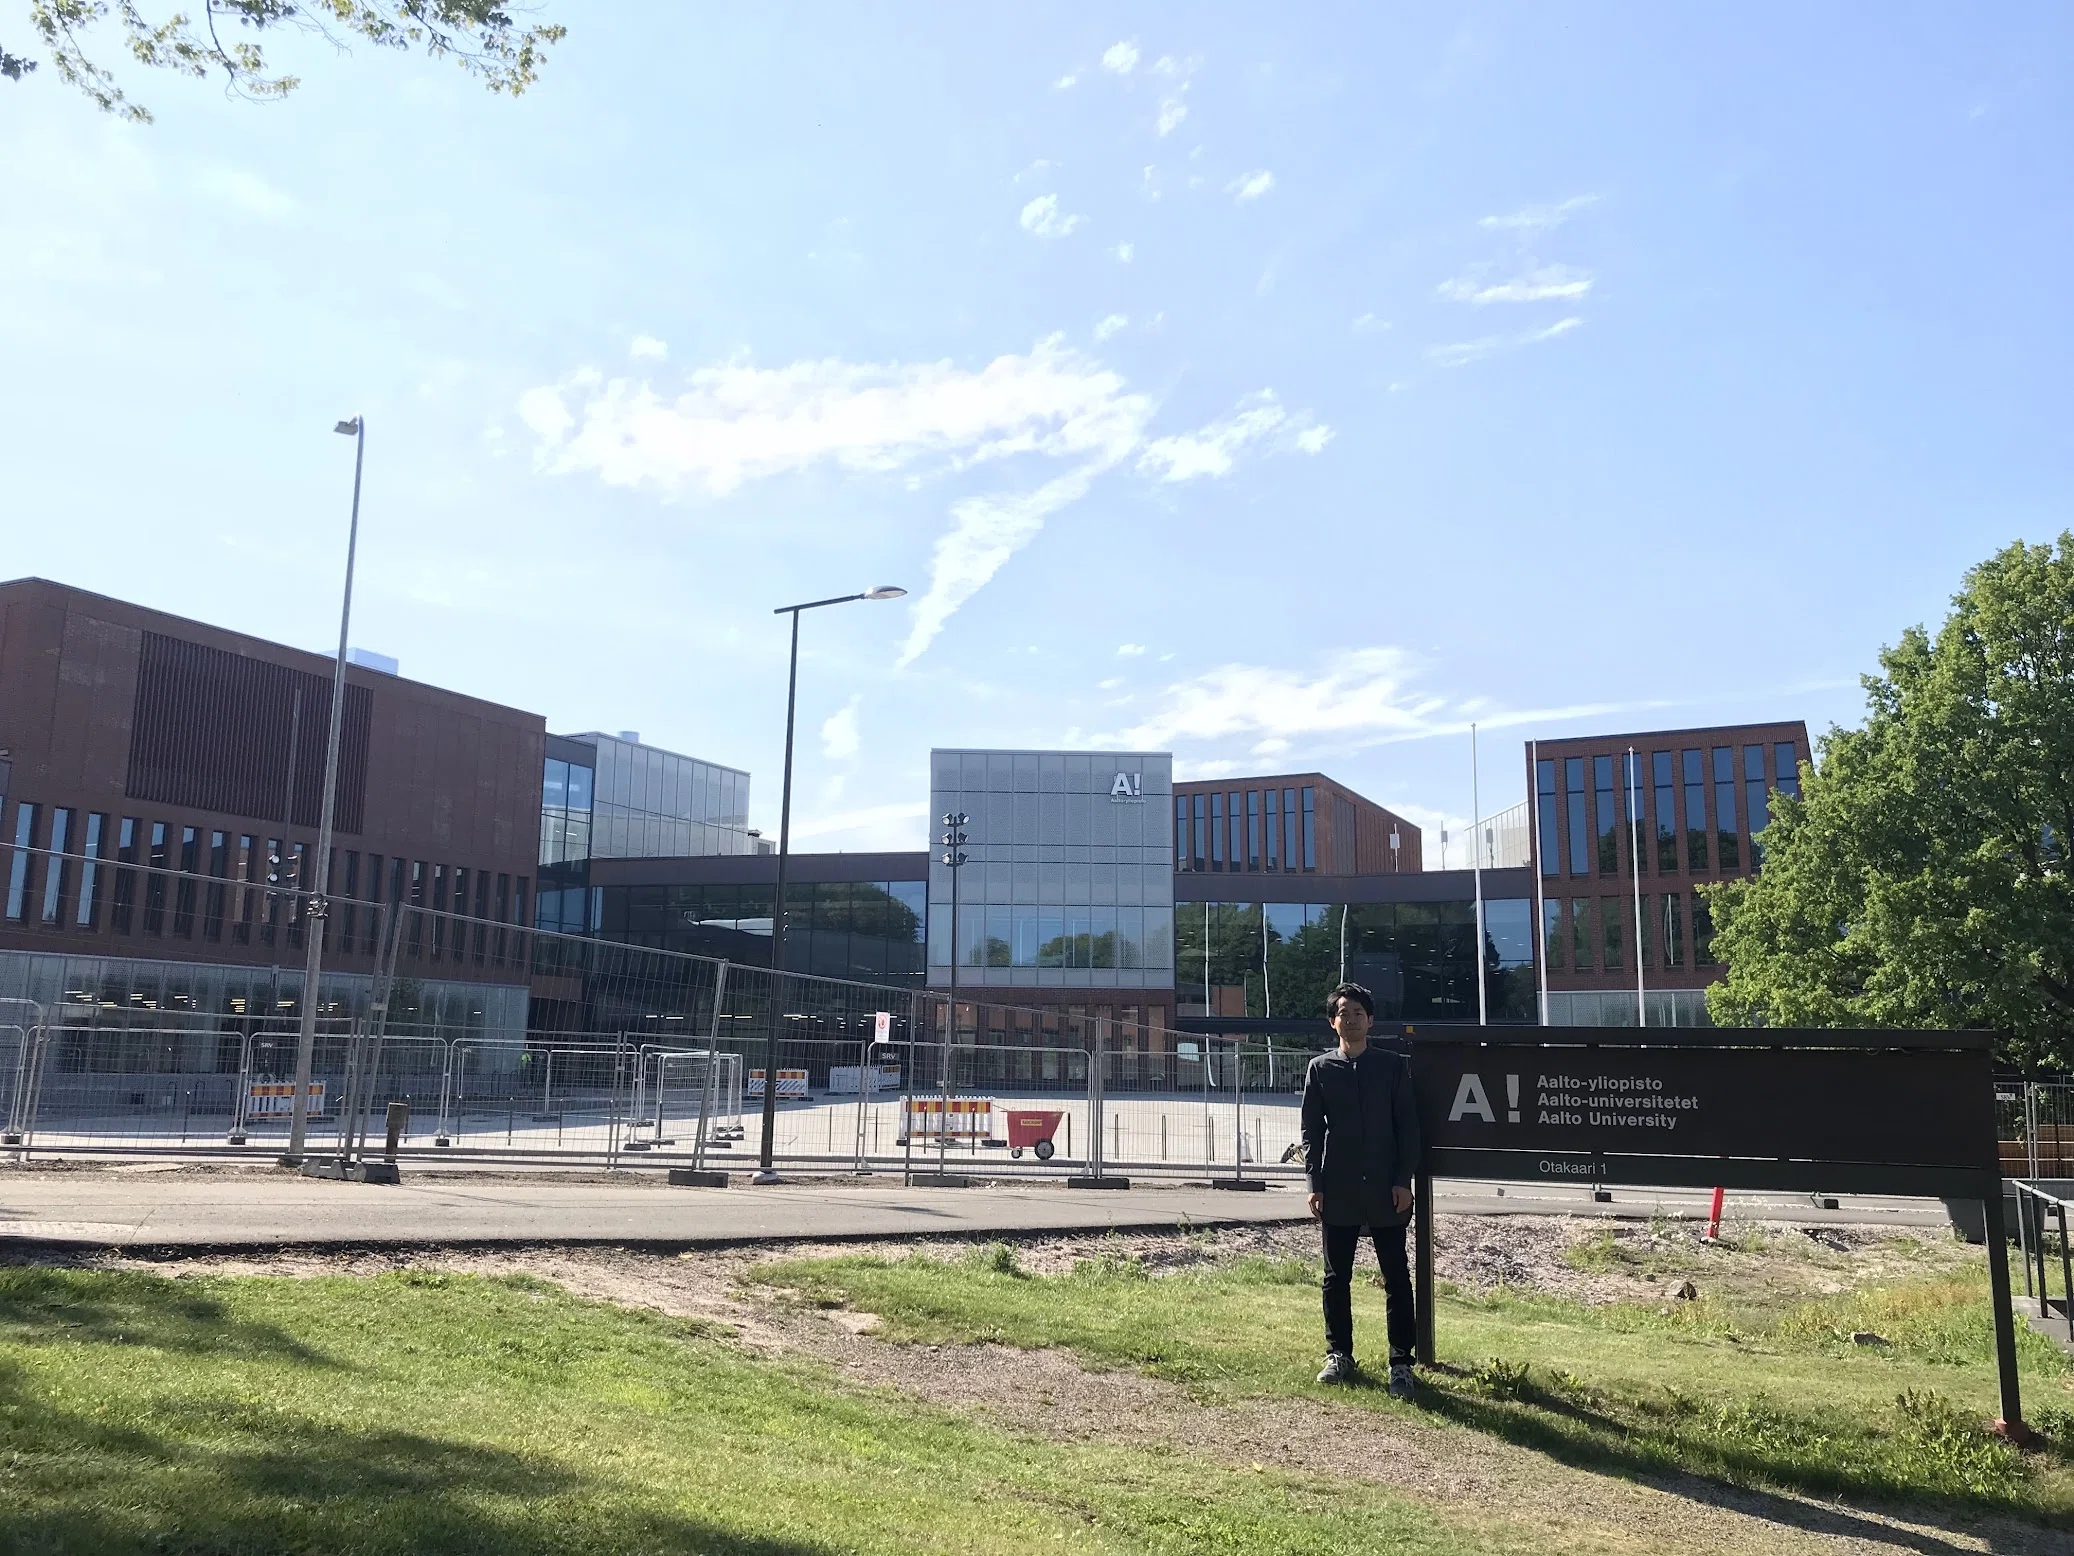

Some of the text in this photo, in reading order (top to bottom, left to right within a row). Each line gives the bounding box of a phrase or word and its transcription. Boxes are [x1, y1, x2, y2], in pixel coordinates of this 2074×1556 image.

[1110, 772, 1141, 796] A!
[1536, 1074, 1663, 1092] Aalto-yliopisto
[1447, 1073, 1521, 1123] A!
[1537, 1092, 1699, 1109] Aalto-universitetet
[1538, 1110, 1677, 1129] Aalto University
[1539, 1160, 1607, 1175] Otakaari 1
